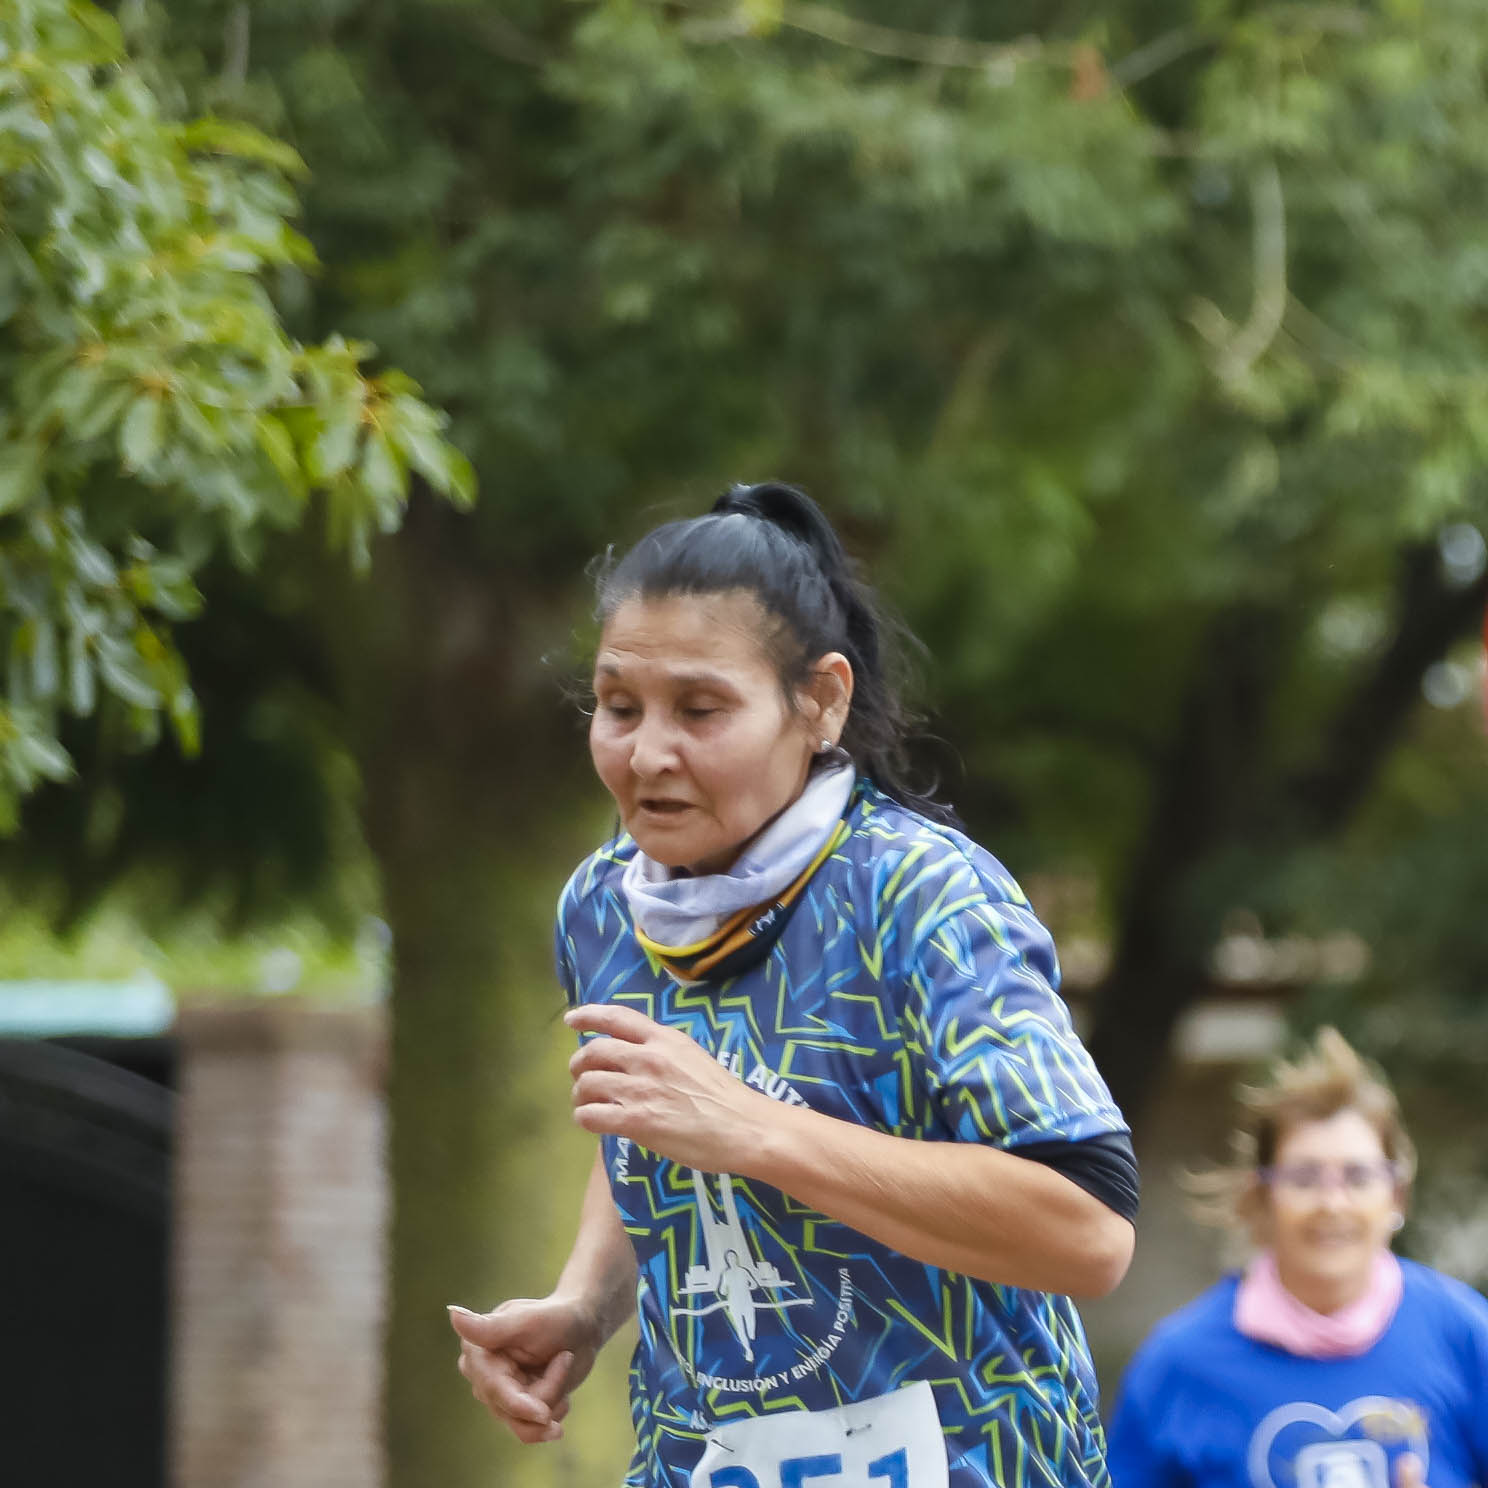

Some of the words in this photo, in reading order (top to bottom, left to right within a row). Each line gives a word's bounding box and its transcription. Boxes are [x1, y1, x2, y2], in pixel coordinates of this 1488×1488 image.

[745, 1063, 810, 1109] AUT
[780, 1371, 791, 1385] Y
[832, 1267, 852, 1334] POSITIVA
